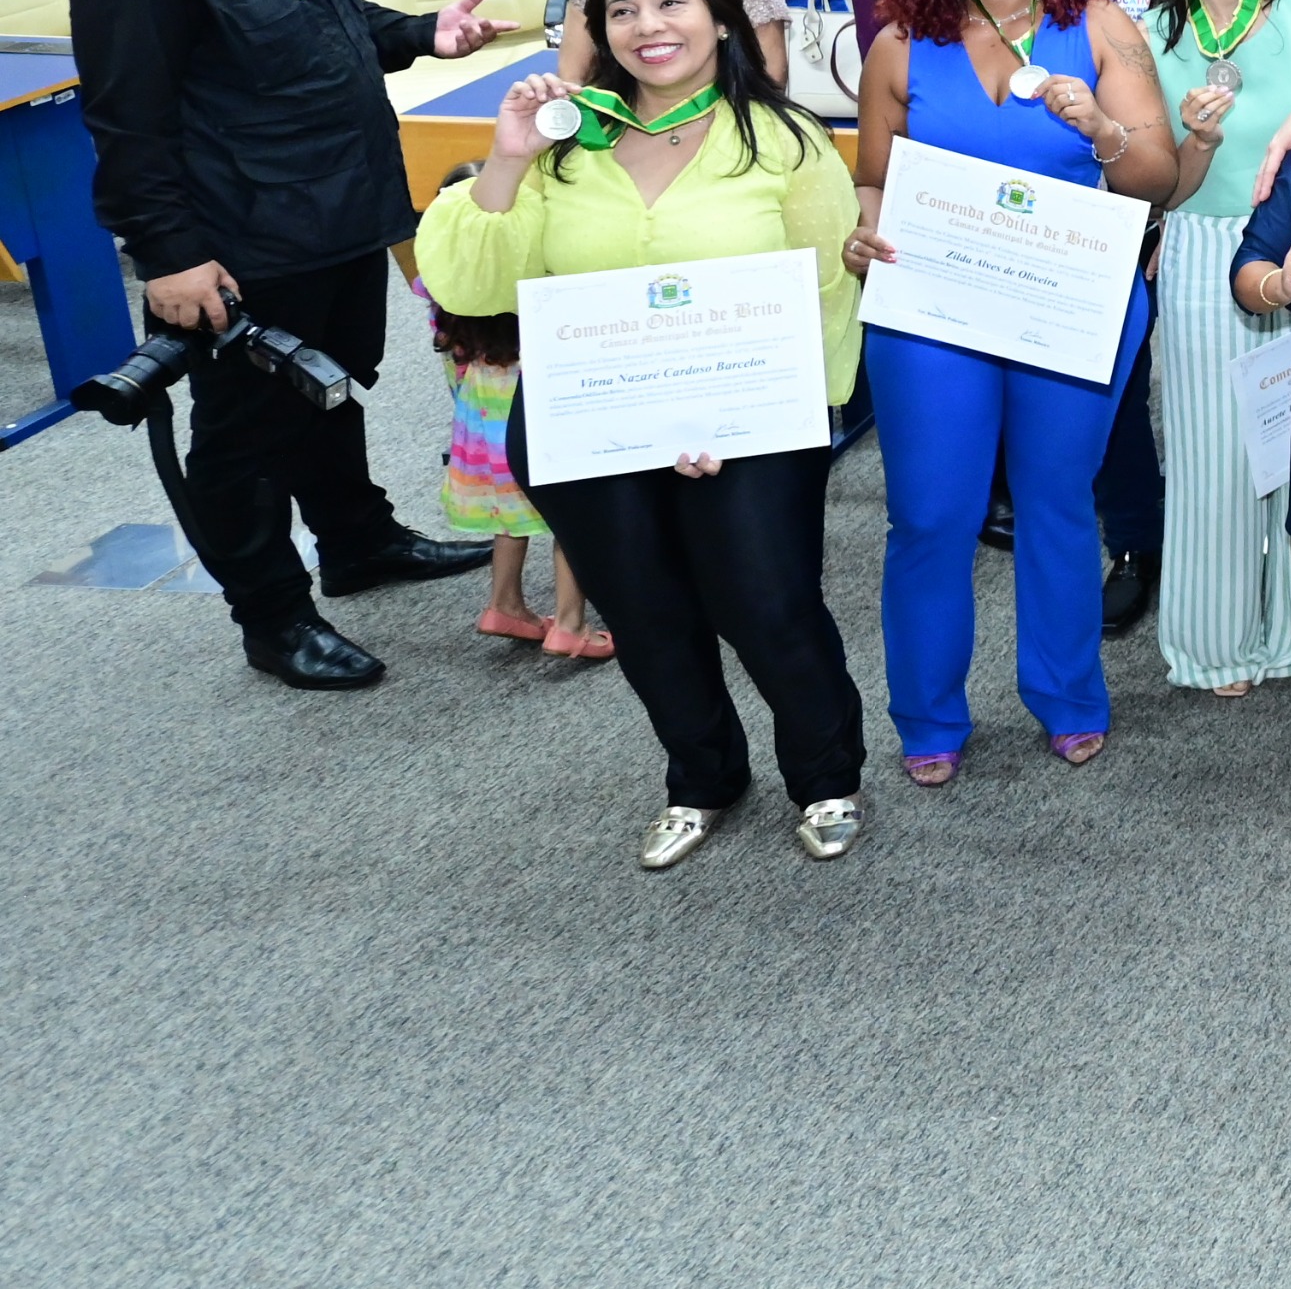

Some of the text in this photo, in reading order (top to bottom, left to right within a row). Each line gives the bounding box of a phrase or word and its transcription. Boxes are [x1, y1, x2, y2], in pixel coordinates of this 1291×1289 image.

[916, 190, 985, 222] Comenda
[1044, 224, 1060, 241] de
[1065, 229, 1108, 253] Brito
[946, 250, 972, 265] Zilda
[973, 259, 1001, 272] Alves
[1004, 266, 1016, 276] de
[1019, 270, 1059, 288] Oliveira
[556, 319, 640, 341] Comenda
[709, 308, 728, 323] de
[734, 301, 783, 322] Brito
[582, 357, 766, 388] Virna Nazaré Cardoso Barcelos
